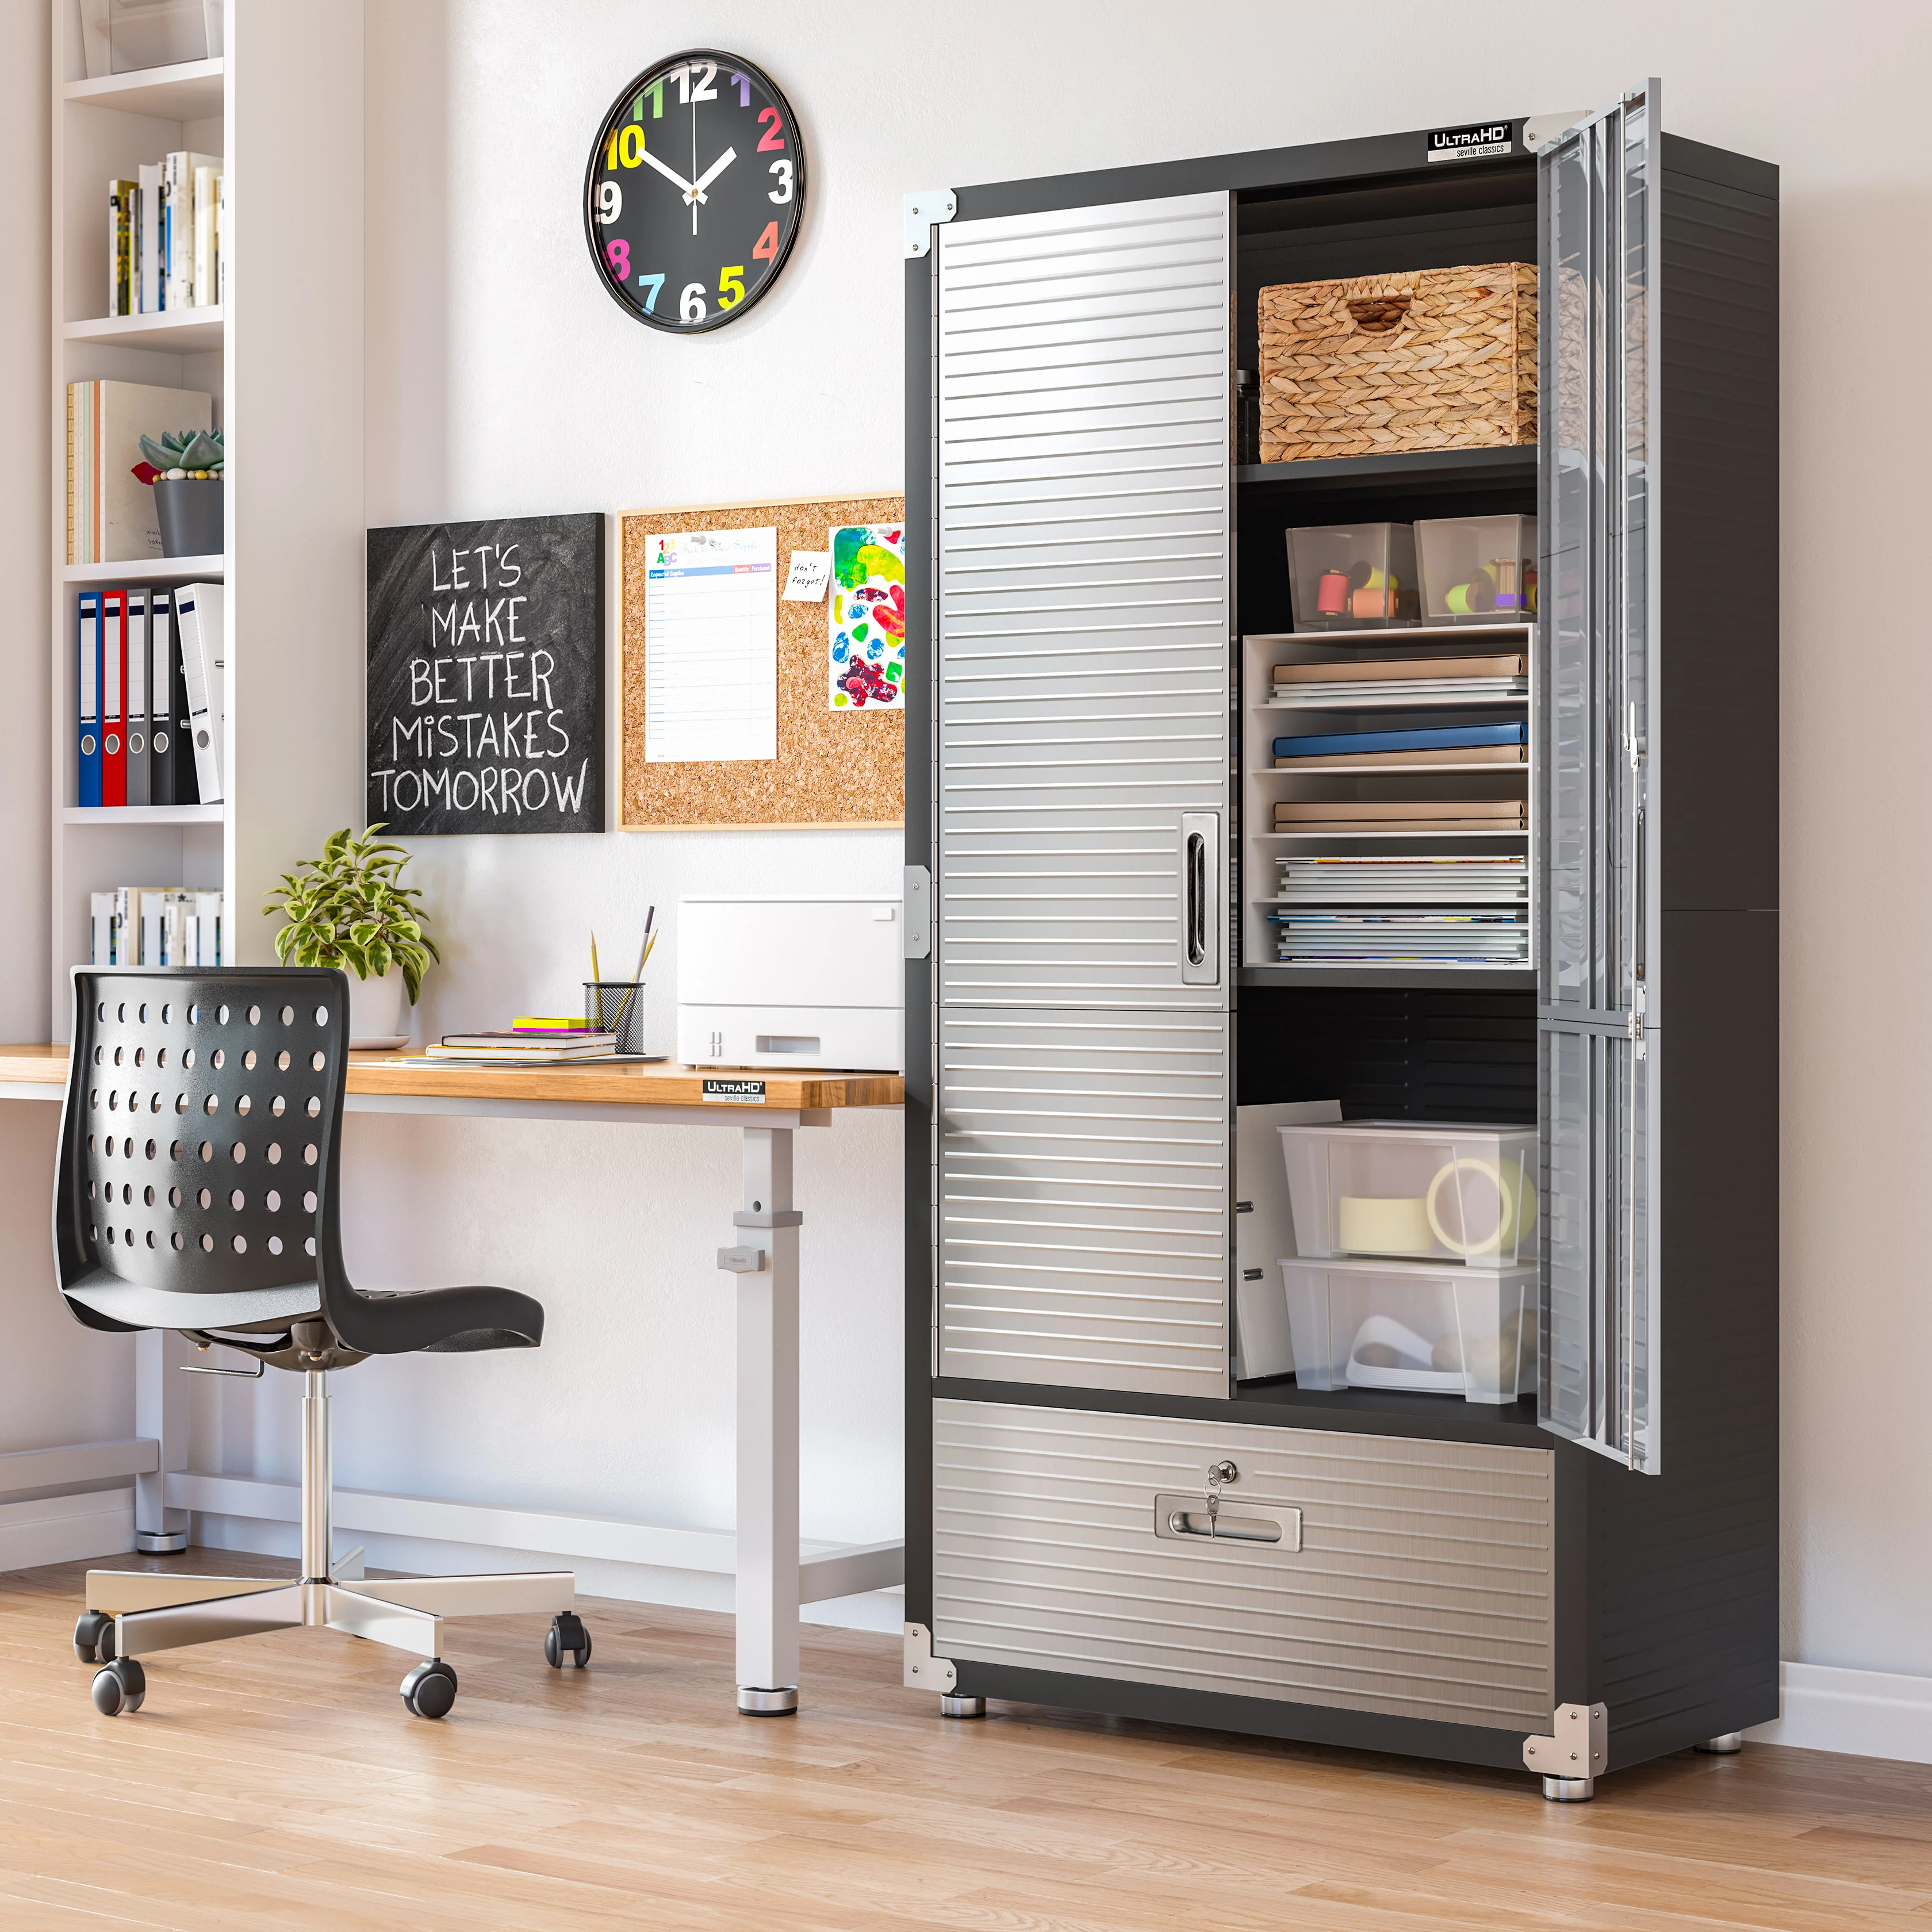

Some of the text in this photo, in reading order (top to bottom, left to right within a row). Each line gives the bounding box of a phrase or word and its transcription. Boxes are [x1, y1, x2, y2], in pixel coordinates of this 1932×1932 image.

[633, 75, 663, 121] 11
[670, 62, 718, 104] 12
[731, 70, 750, 107] 1
[605, 124, 646, 171] 10
[757, 107, 785, 152] 2
[1456, 144, 1504, 157] seville classics
[599, 181, 622, 225] 9
[768, 159, 793, 204] 3
[604, 239, 631, 282] 8
[752, 221, 779, 266] 4
[638, 273, 665, 316] 7
[680, 282, 707, 323] 6
[718, 265, 746, 312] 5
[432, 543, 522, 592] LET'S
[792, 574, 826, 588] forget!
[795, 562, 818, 572] don't
[432, 596, 527, 648] MAKE
[409, 649, 554, 710] BETTER
[371, 757, 588, 816] TOMORROW
